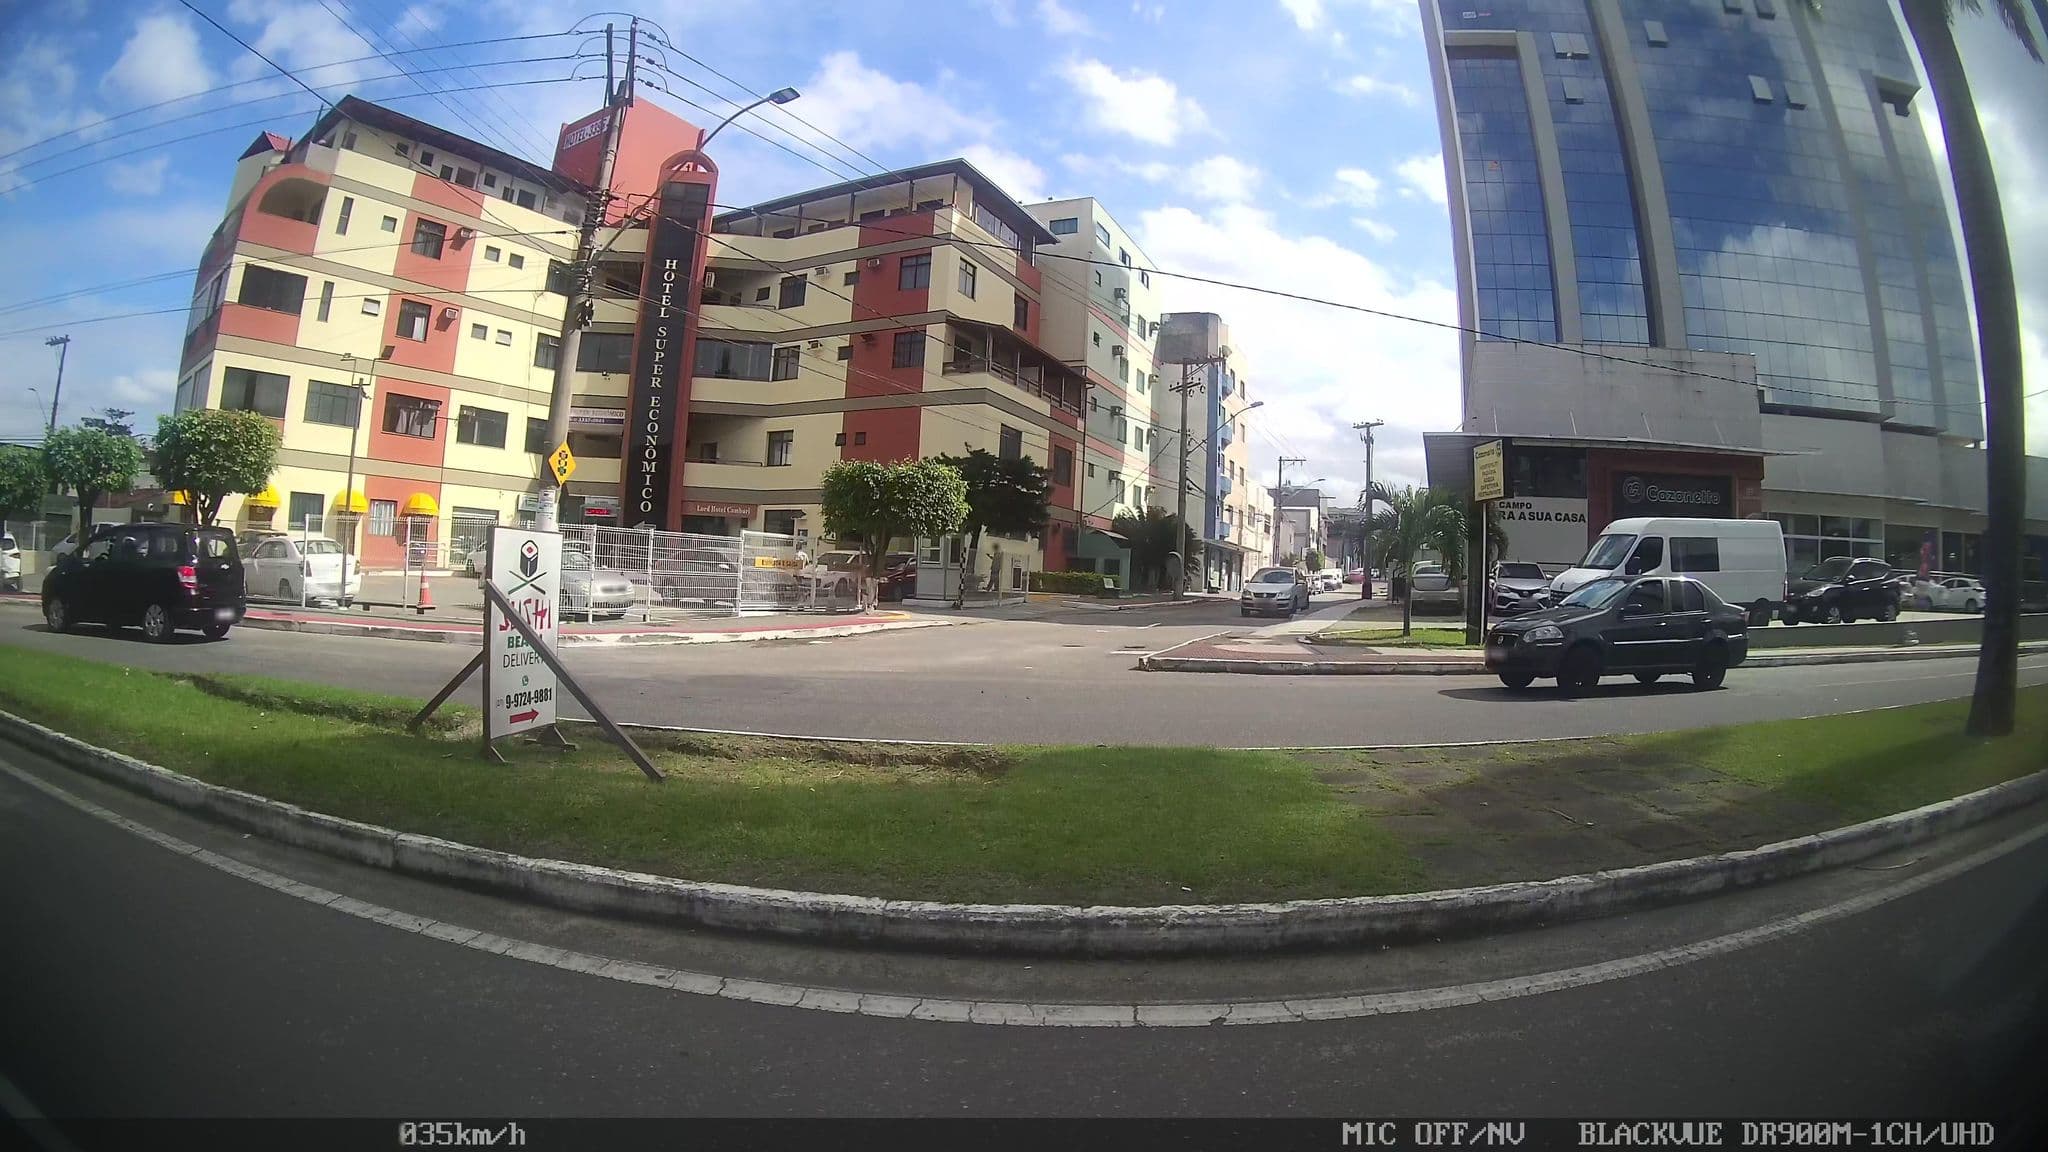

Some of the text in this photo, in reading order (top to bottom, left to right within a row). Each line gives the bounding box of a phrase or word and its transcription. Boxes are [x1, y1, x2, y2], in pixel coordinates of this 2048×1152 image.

[640, 259, 678, 512] HOTEL SUPER ECONÔMICO
[1499, 501, 1532, 510] CAMPO
[1528, 511, 1553, 521] SUA
[1554, 512, 1586, 523] CASA
[505, 687, 552, 709] 9-9724-9881
